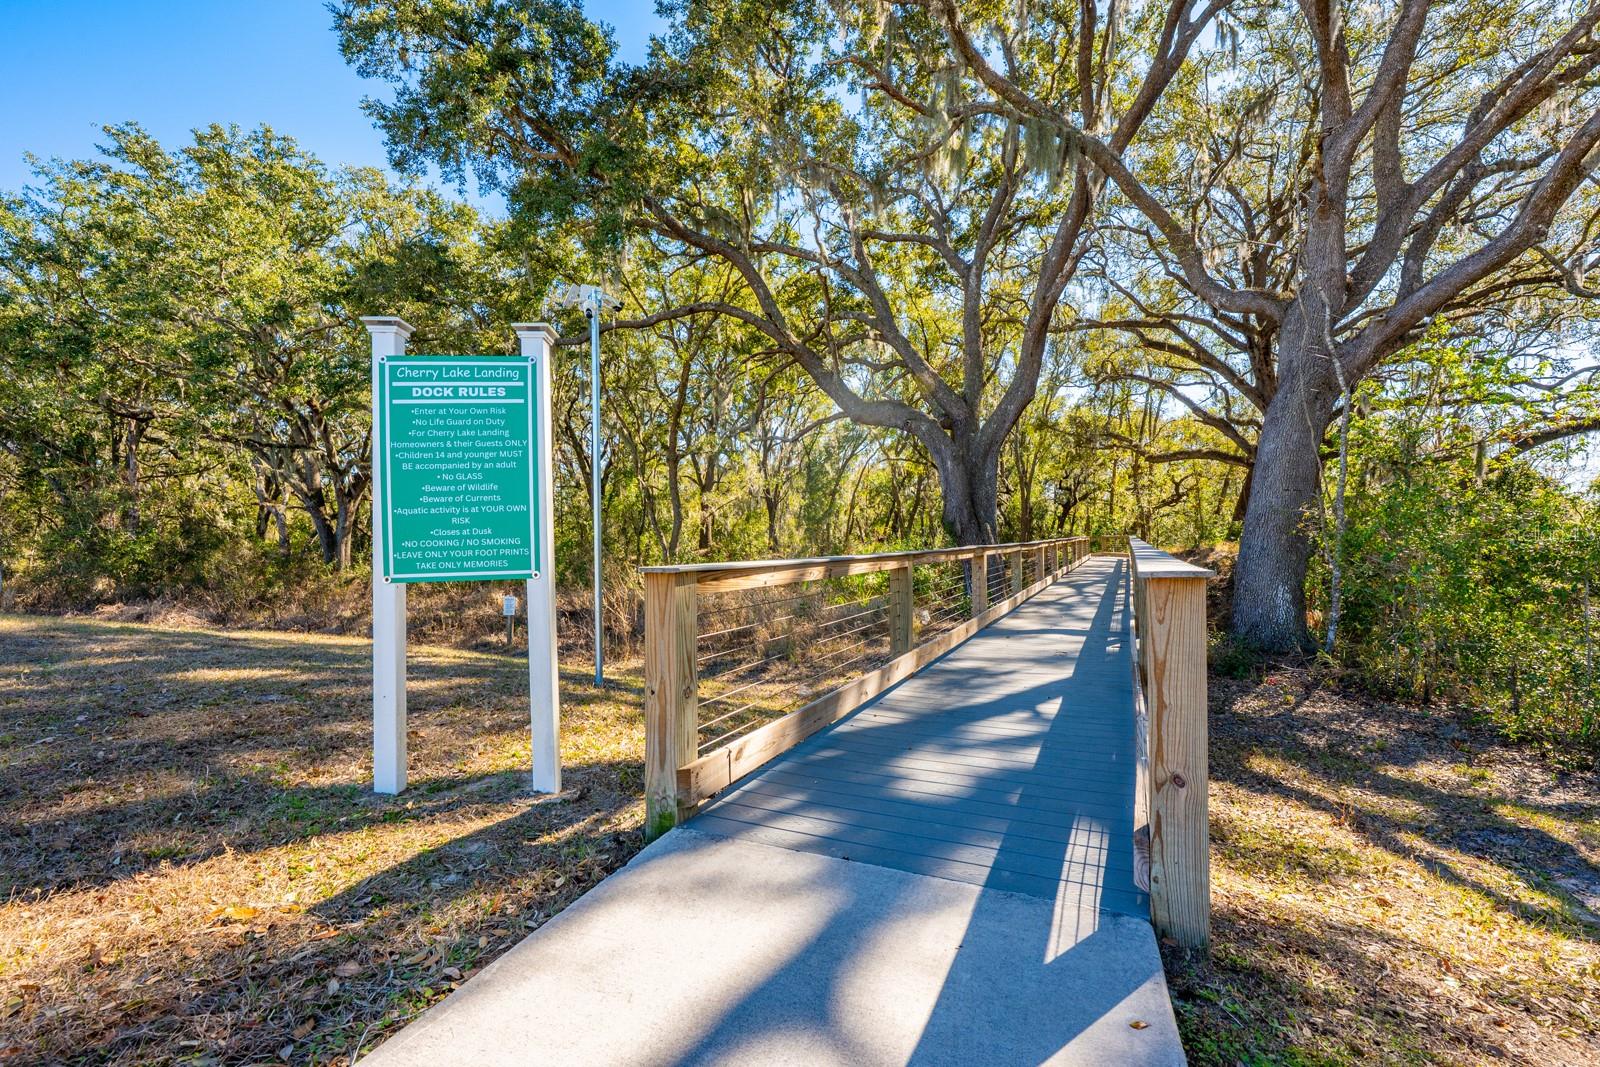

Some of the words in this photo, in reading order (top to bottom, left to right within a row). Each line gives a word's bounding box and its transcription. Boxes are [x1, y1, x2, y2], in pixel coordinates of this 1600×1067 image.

[397, 367, 439, 381] Cherry
[442, 367, 471, 378] Lake
[474, 367, 519, 381] Landing
[412, 387, 453, 397] DOCK
[458, 387, 506, 397] RULES
[448, 407, 467, 415] Your
[470, 407, 488, 415] Own
[490, 407, 506, 415] Risk
[485, 418, 505, 427] Duty
[427, 429, 455, 438] Cherry
[478, 429, 509, 437] Landing
[465, 451, 497, 460] younger
[415, 462, 470, 471] accompanied
[472, 462, 482, 471] by
[467, 483, 499, 491] Wildlife
[419, 539, 460, 547] COOKING
[475, 549, 497, 557] FOOT
[500, 548, 529, 556] PRINTS
[416, 562, 437, 570] TAKE
[439, 561, 462, 569] ONLY
[464, 560, 508, 568] MEMORIES
